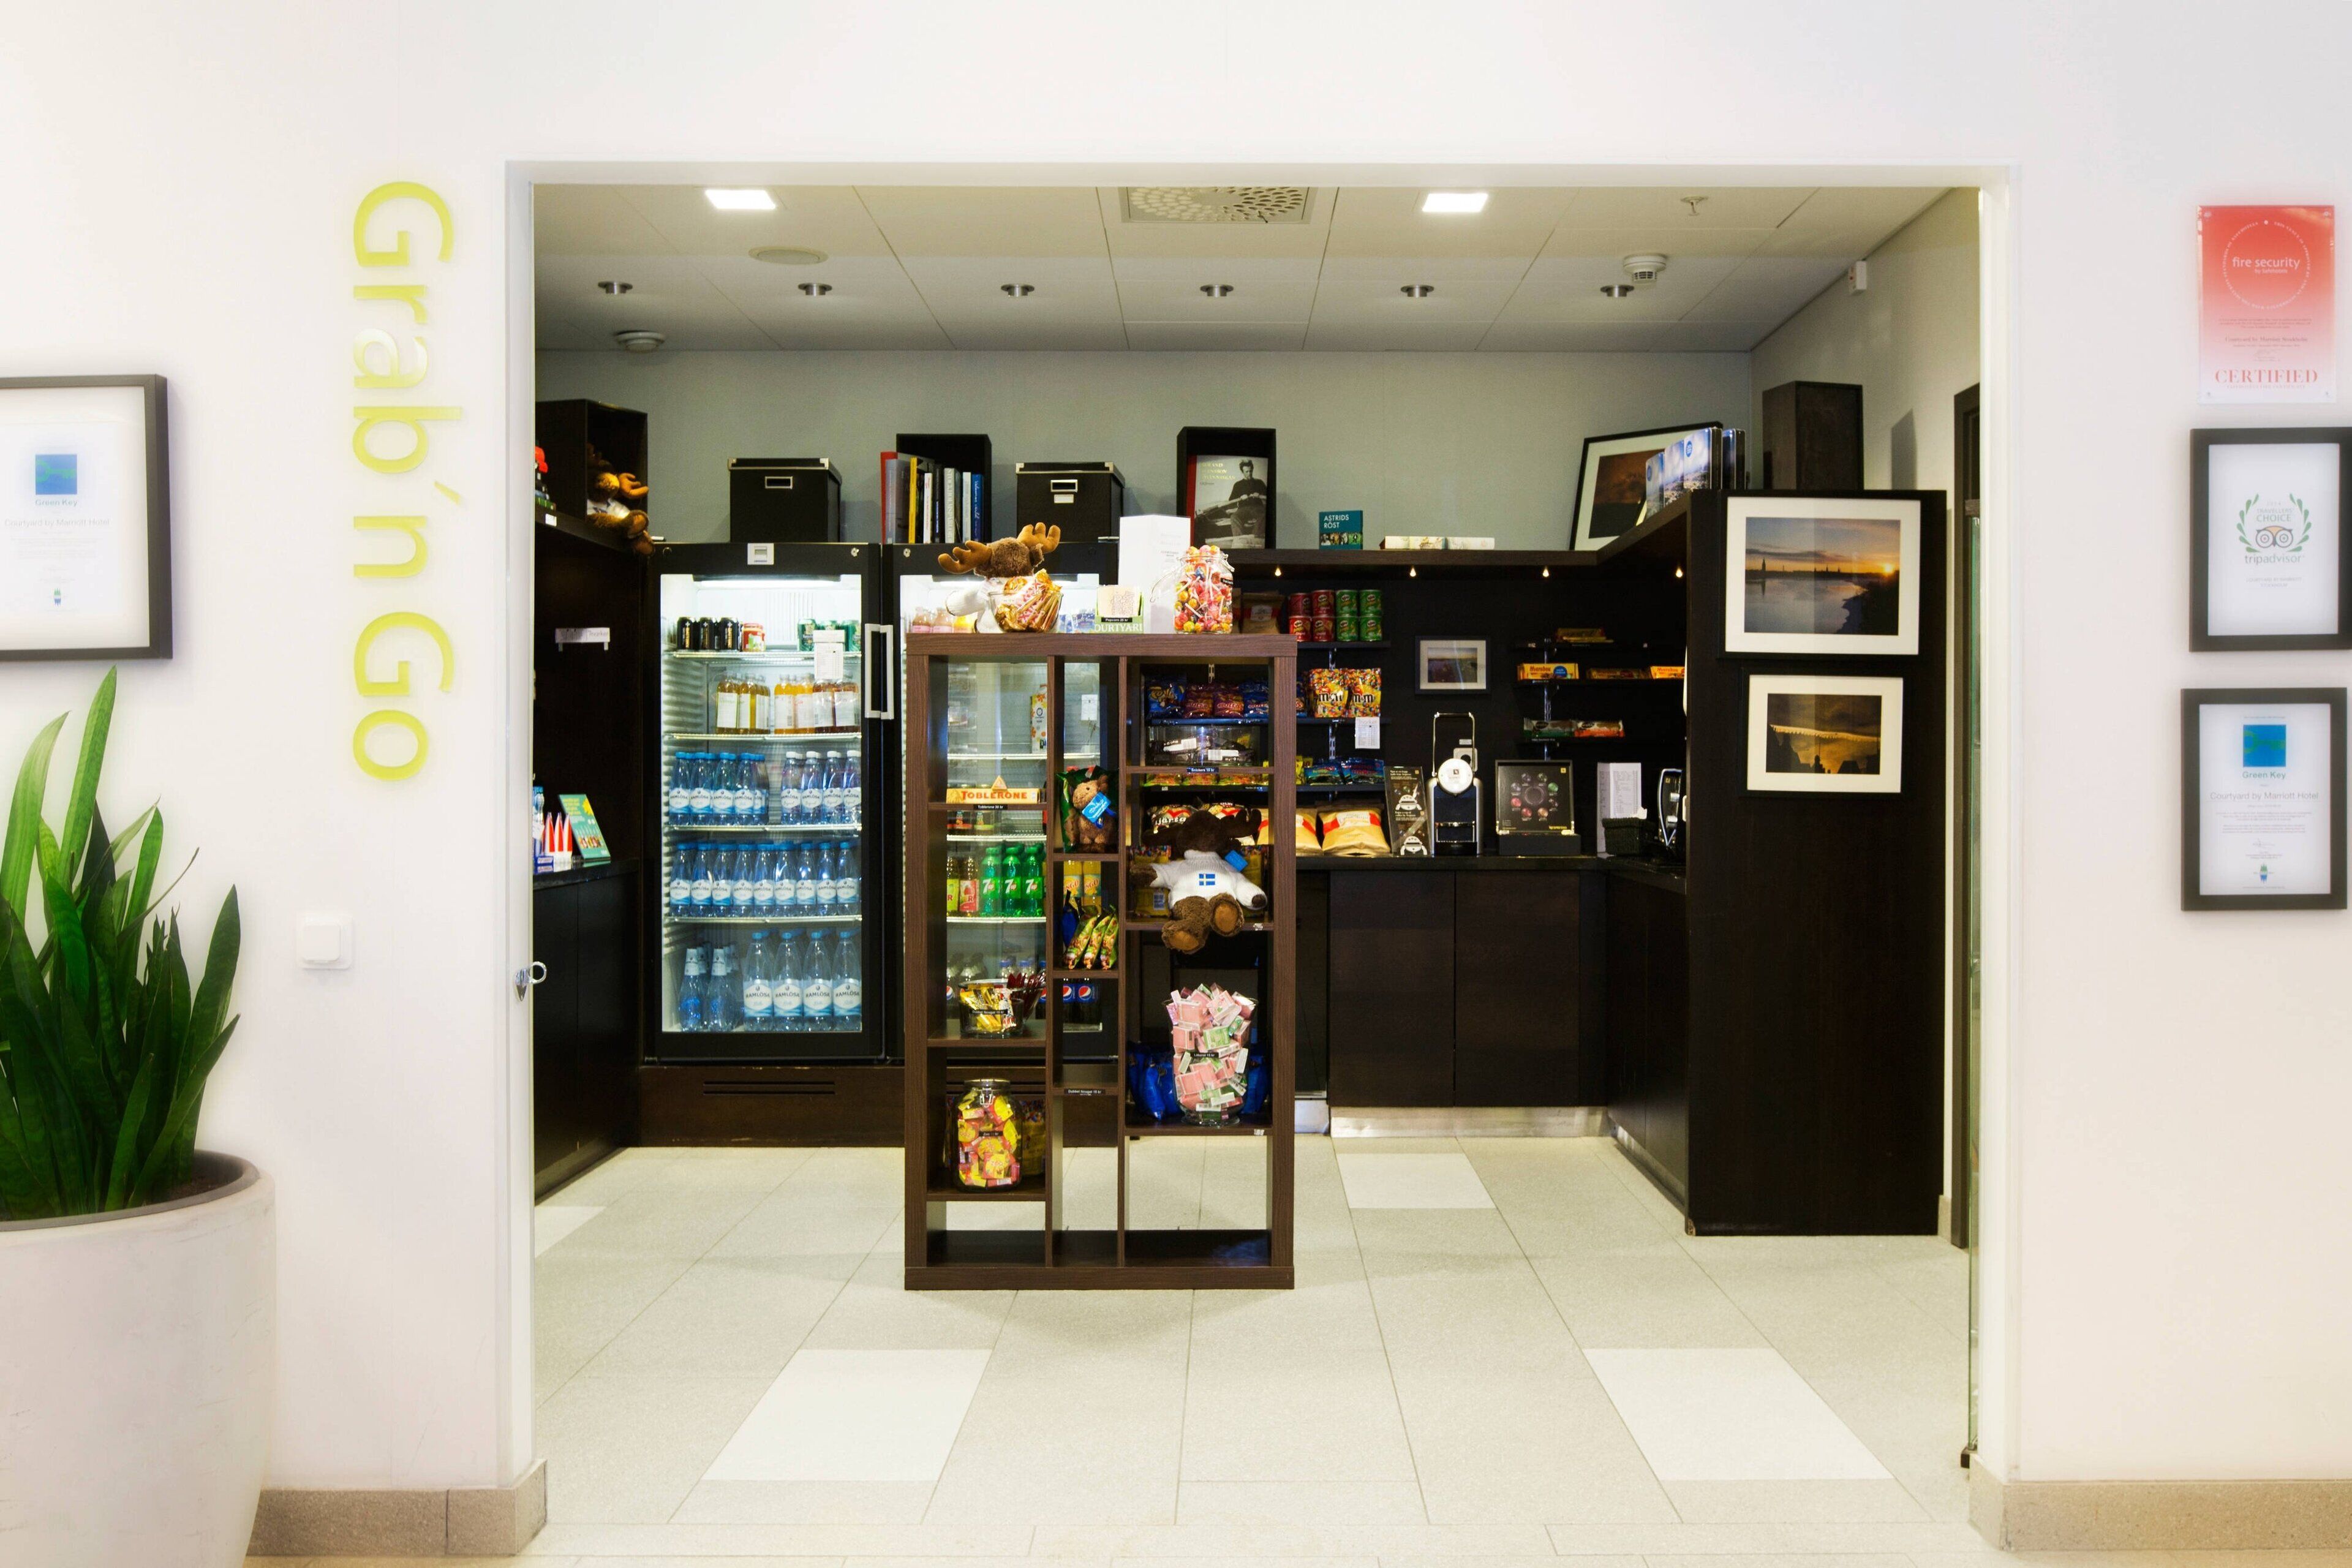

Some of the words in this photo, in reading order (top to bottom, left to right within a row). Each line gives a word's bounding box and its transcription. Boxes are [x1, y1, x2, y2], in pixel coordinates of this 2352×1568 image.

[2233, 256, 2252, 267] fire
[2255, 257, 2300, 270] security
[2215, 369, 2318, 383] CERTIFIED
[61, 499, 78, 507] Key
[2245, 554, 2301, 565] tripadvisor
[1095, 623, 1143, 632] OURTYAR
[353, 612, 454, 780] Go
[962, 790, 1027, 800] TOBLERONE
[2210, 792, 2249, 801] Courtyard
[2252, 792, 2261, 801] by
